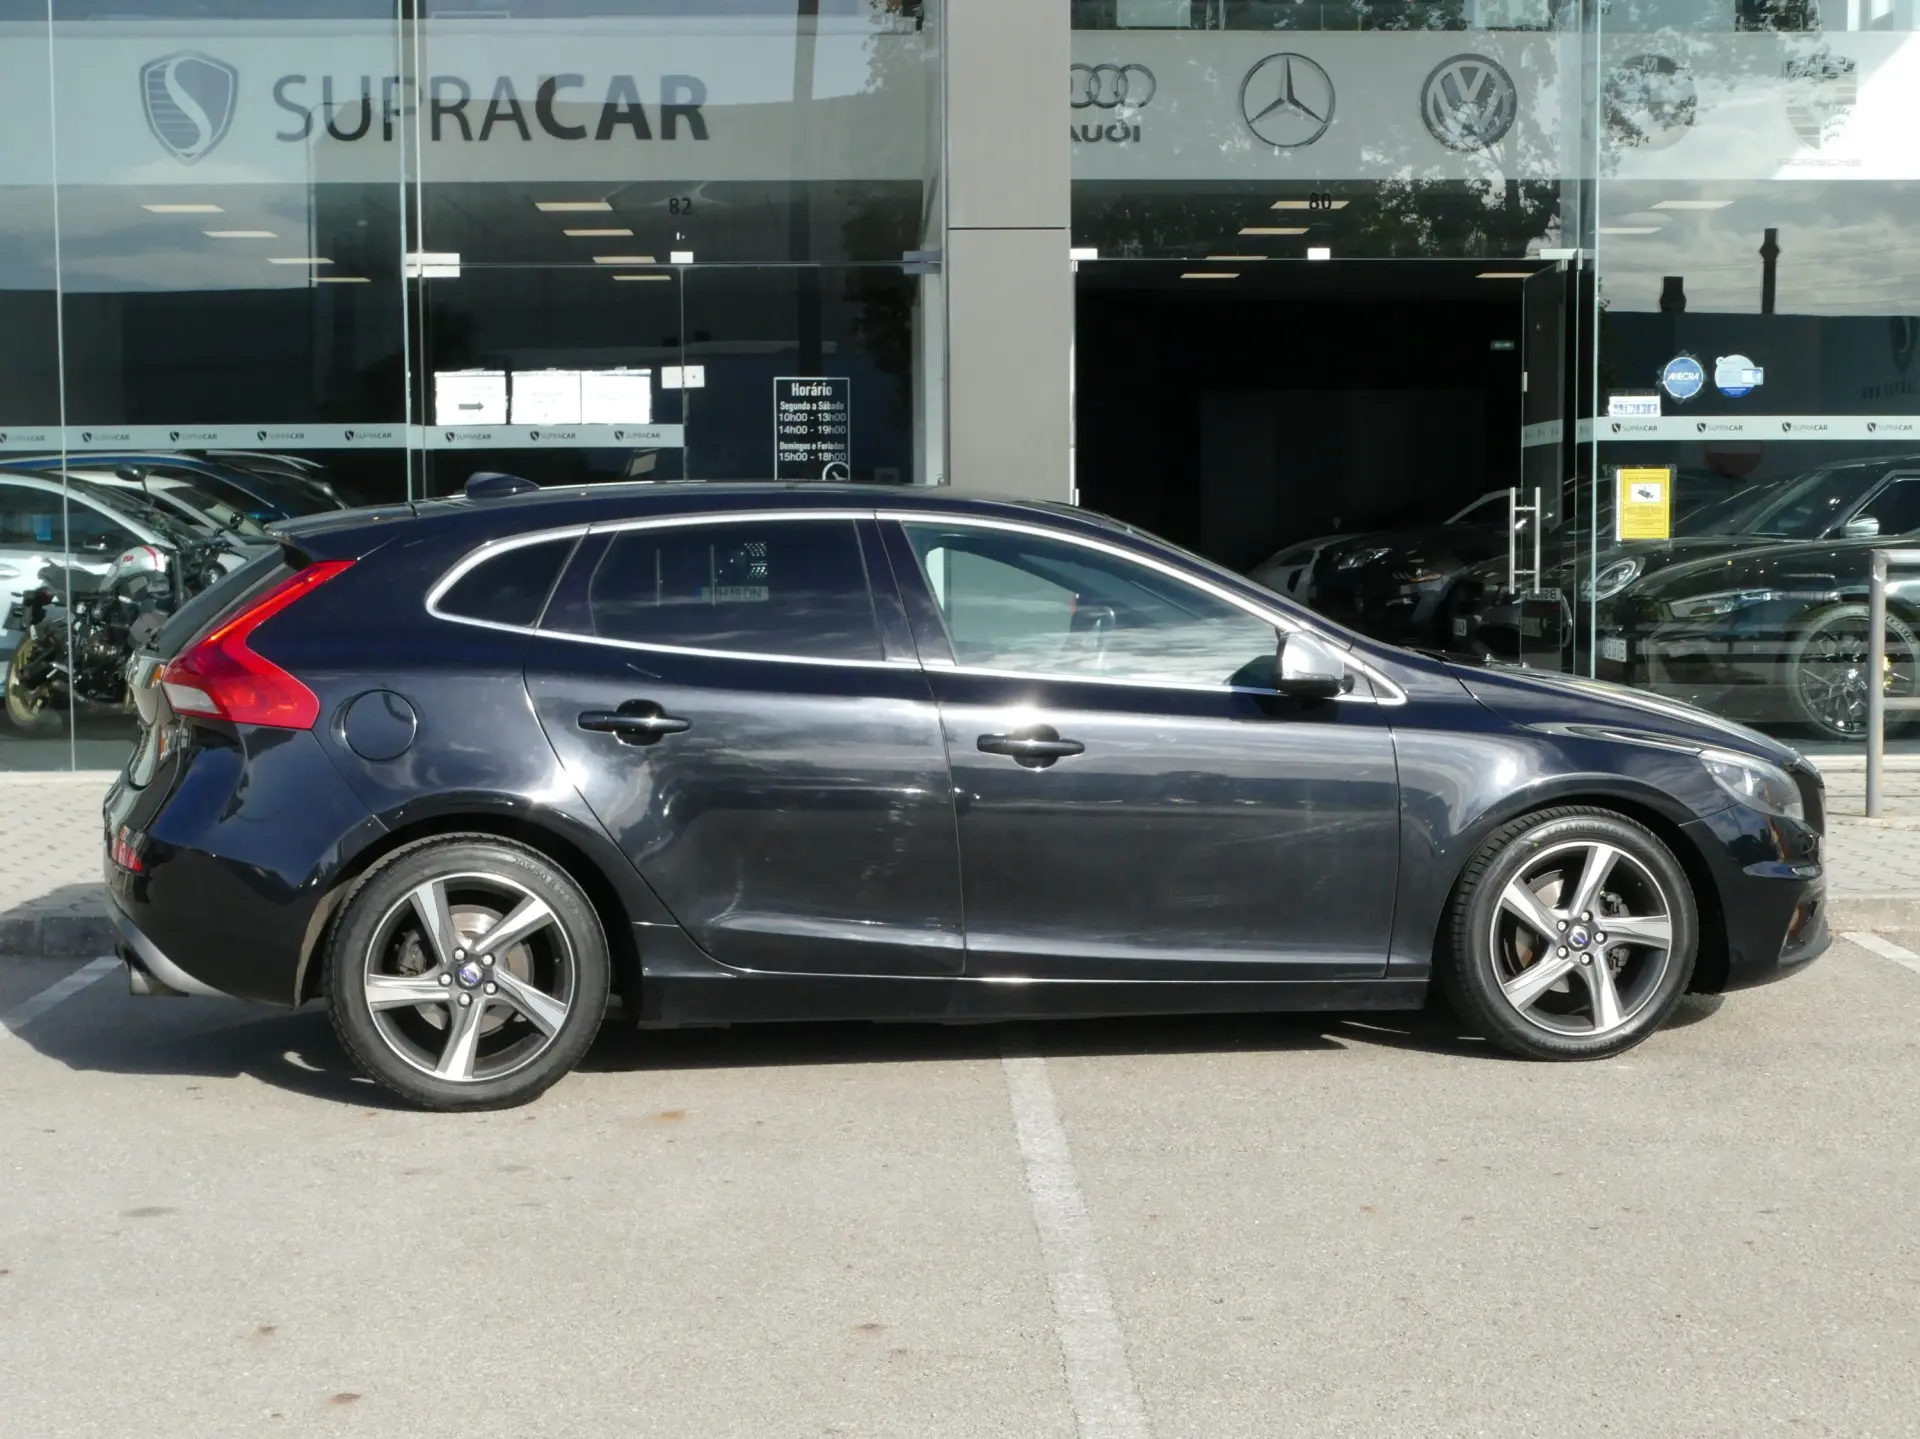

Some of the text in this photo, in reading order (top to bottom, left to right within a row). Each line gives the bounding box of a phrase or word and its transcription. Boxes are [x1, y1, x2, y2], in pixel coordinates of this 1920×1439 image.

[272, 73, 710, 142] SUPRACAR
[1309, 192, 1332, 210] 80
[668, 198, 693, 216] 82
[791, 382, 833, 397] Horário
[780, 401, 811, 412] Segunda
[818, 401, 845, 411] Sábado
[778, 413, 808, 422] 10h00
[817, 413, 846, 422] 13h00
[778, 425, 808, 434] 14h00
[817, 425, 846, 434] 19h00
[779, 441, 811, 452] Domingos
[778, 452, 808, 461] 15h00
[817, 452, 847, 461] 18h00
